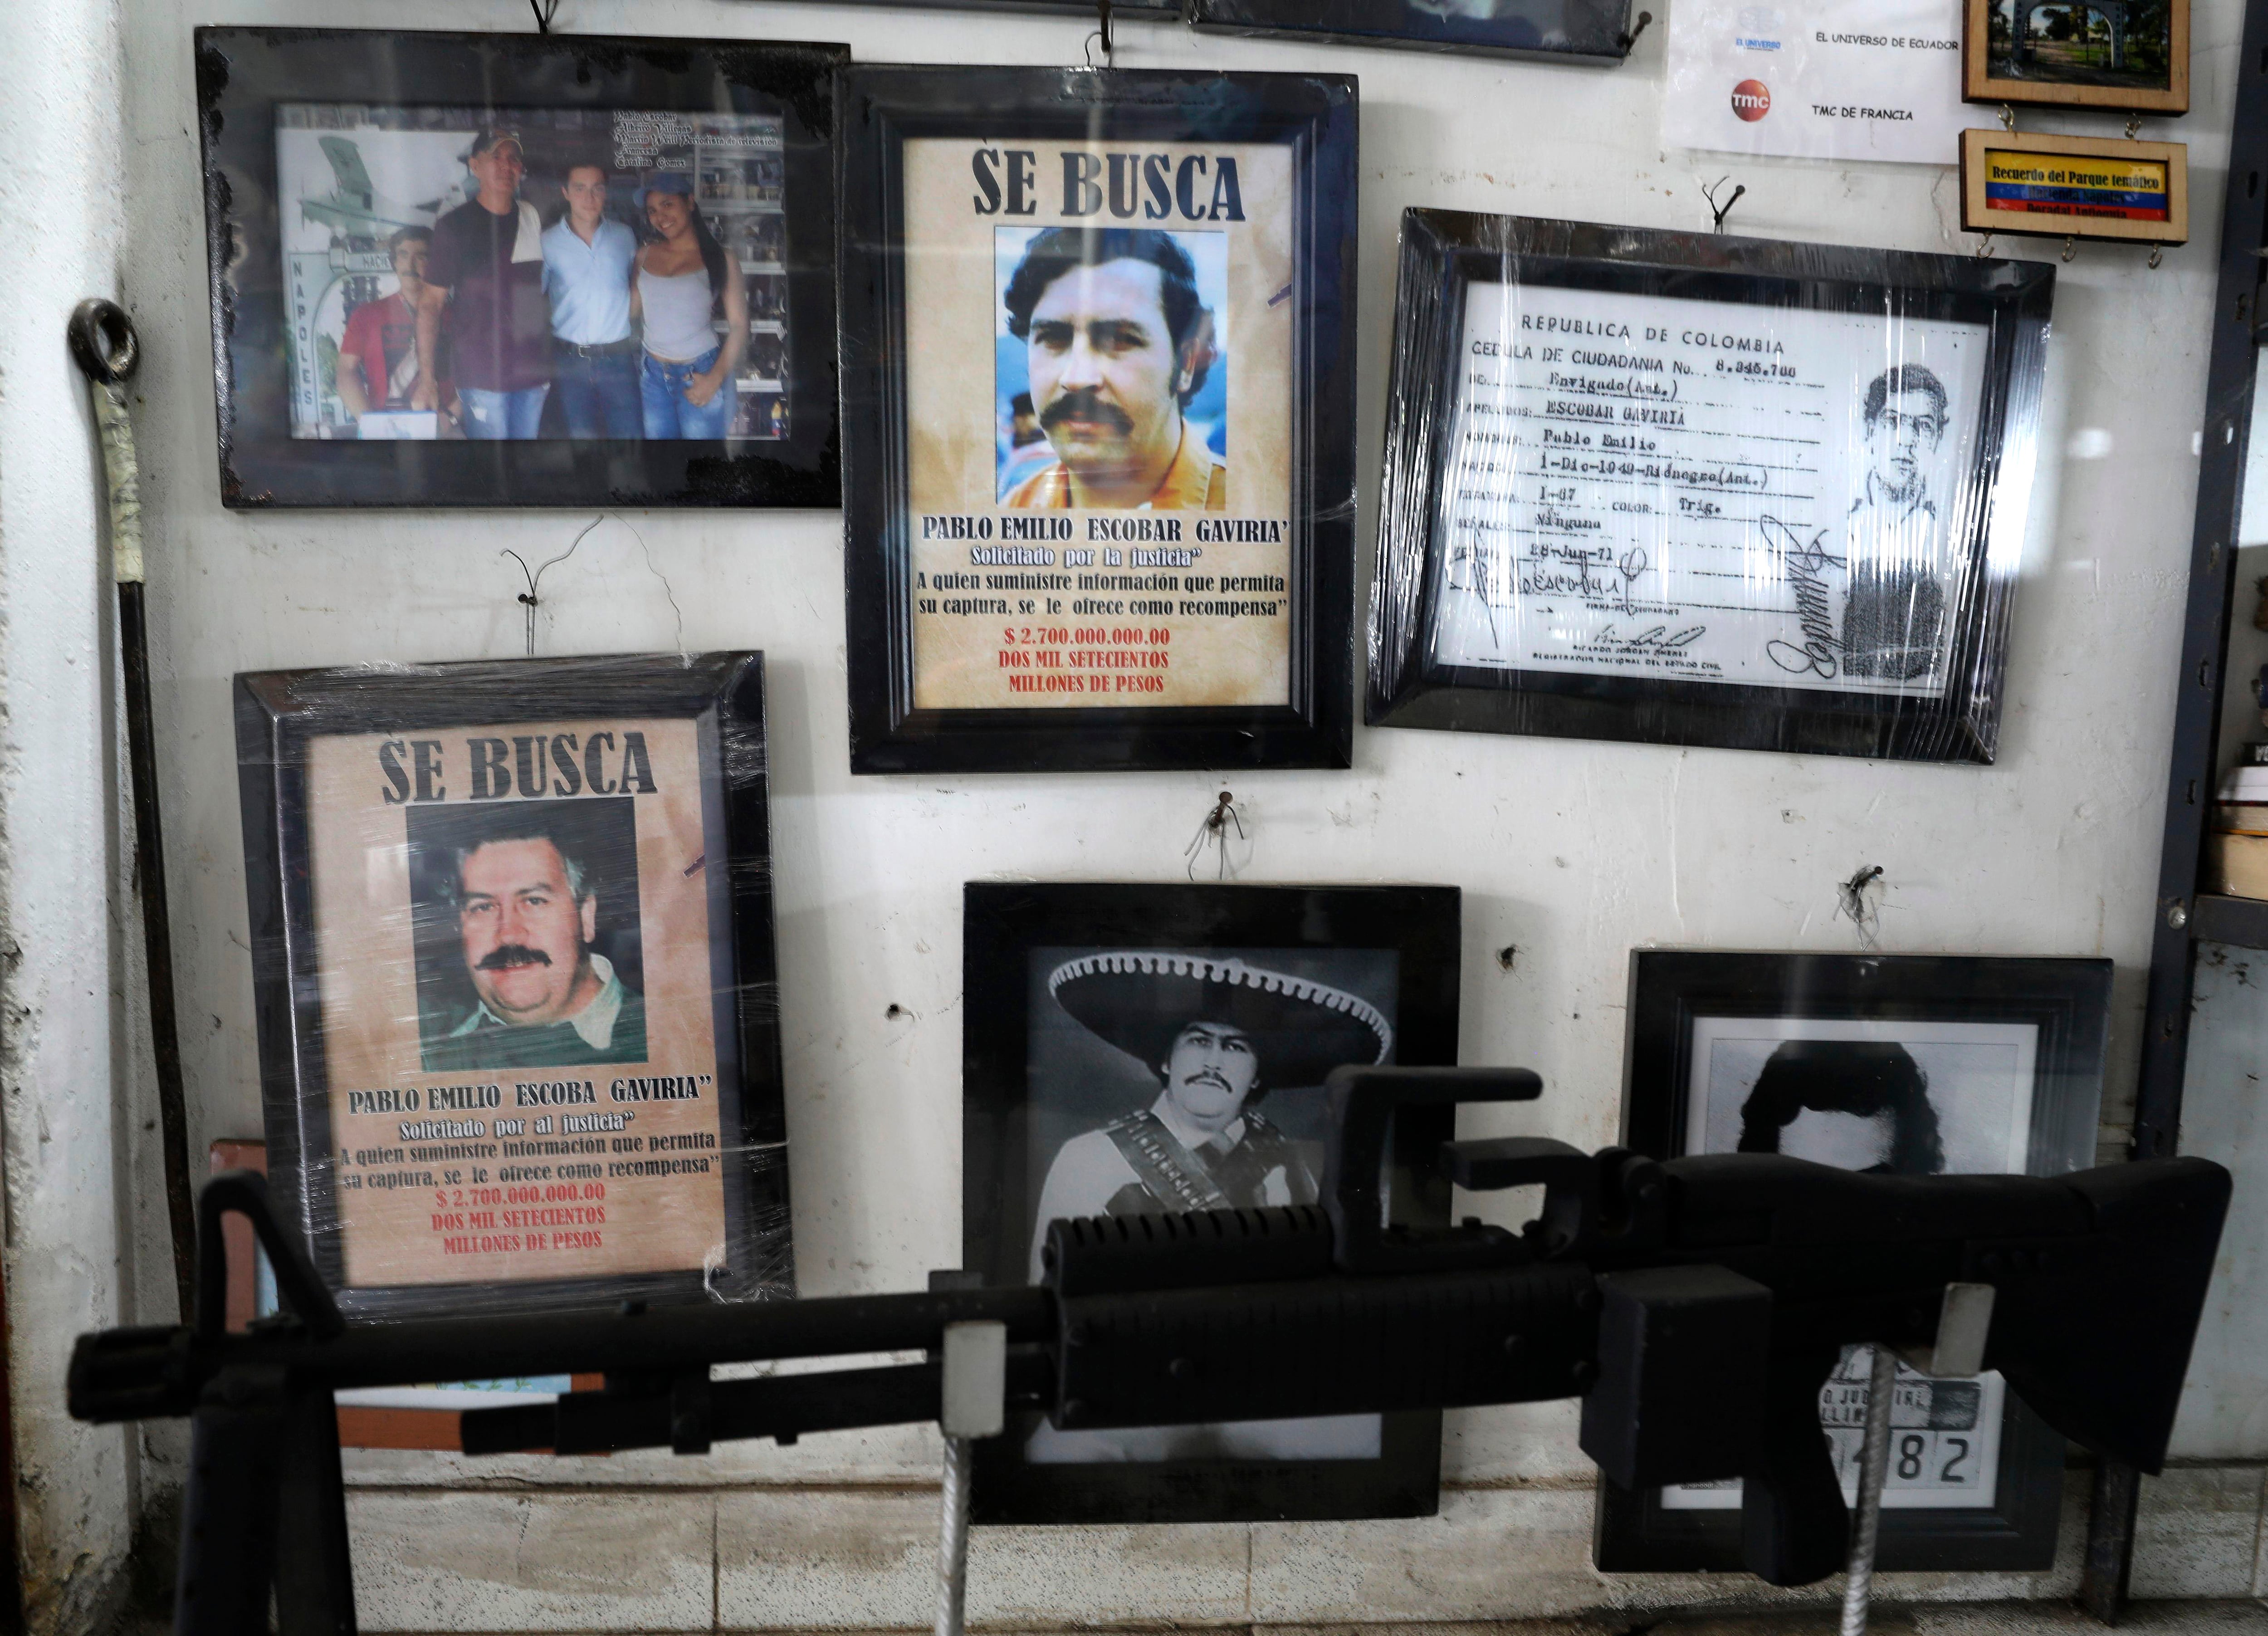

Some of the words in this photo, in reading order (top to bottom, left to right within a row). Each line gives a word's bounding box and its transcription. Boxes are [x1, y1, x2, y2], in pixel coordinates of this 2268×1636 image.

[1745, 39, 1781, 49] UNIVERSO
[1816, 32, 1828, 43] EL
[1832, 34, 1887, 46] UNIVERSO
[1892, 37, 1905, 48] DE
[1909, 39, 1959, 50] ECUADOR
[1812, 105, 1837, 117] TMC
[1841, 107, 1857, 118] DE
[1860, 108, 1913, 120] FRANCIA
[973, 148, 1037, 216] SE
[1060, 152, 1246, 222] BUSCA
[1993, 166, 2045, 181] Recuerdo
[2048, 169, 2065, 182] del
[2068, 171, 2109, 188] Parque
[2112, 174, 2159, 189] temático
[293, 261, 313, 405] NAPOLES
[1521, 315, 1631, 339] REPUBLICA
[1646, 327, 1668, 343] DE
[1682, 331, 1784, 354] COLOMBIA
[1471, 340, 1533, 360] CEDULA
[1542, 348, 1564, 362] DE
[1572, 349, 1664, 373] CIUDADANIA
[1546, 399, 1614, 420] ESCOBAR
[1623, 405, 1685, 425] GAVIRIA
[1543, 429, 1591, 445] Pablo
[921, 515, 993, 542] PABLO
[1000, 517, 1074, 543] EMILIO
[1087, 518, 1183, 543] ESCOBAR
[971, 545, 1055, 567] Solicitado
[1064, 549, 1095, 569] por
[1104, 547, 1122, 567] la
[917, 572, 927, 590] A
[933, 572, 981, 593] quien
[986, 573, 1072, 591] suministre
[1077, 572, 1179, 593] información
[1184, 576, 1215, 594] que
[1220, 574, 1285, 595] permita
[919, 599, 938, 615] su
[943, 598, 1013, 617] captura,
[1018, 600, 1036, 616] se
[1046, 597, 1062, 615] le
[1072, 597, 1124, 616] ofrece
[1129, 599, 1175, 617] como
[1004, 627, 1016, 646] $
[1020, 627, 1171, 646] 2.700.000.000.00
[998, 650, 1031, 669] DOS
[1035, 651, 1064, 669] MIL
[1068, 651, 1170, 669] SETECIENTOS
[1009, 675, 1085, 693] MILLONES
[1090, 675, 1111, 693] DE
[1115, 675, 1165, 693] PESOS
[378, 740, 447, 806] SE
[465, 731, 658, 802] BUSCA
[348, 1089, 421, 1115] PABLO
[427, 1084, 502, 1112] EMILIO
[515, 1080, 598, 1108] ESCOBA
[400, 1120, 486, 1141] Solicitado
[494, 1118, 525, 1139] por
[534, 1115, 552, 1135] al
[340, 1148, 349, 1166] A
[357, 1145, 405, 1167] quien
[410, 1142, 498, 1164] suministre
[503, 1136, 607, 1160] información
[612, 1137, 644, 1155] que
[649, 1131, 716, 1154] permita
[343, 1172, 363, 1190] su
[367, 1168, 439, 1190] captura,
[444, 1169, 463, 1186] se
[472, 1165, 488, 1185] le
[499, 1162, 553, 1184] ofrece
[557, 1163, 603, 1180] como
[436, 1190, 448, 1208] $
[453, 1182, 607, 1207] 2.700.000.000.00
[432, 1213, 464, 1232] DOS
[469, 1212, 498, 1230] MIL
[503, 1206, 607, 1229] SETECIENTOS
[442, 1234, 522, 1255] MILLONES
[525, 1233, 547, 1252] DE
[552, 1230, 603, 1250] PESOS
